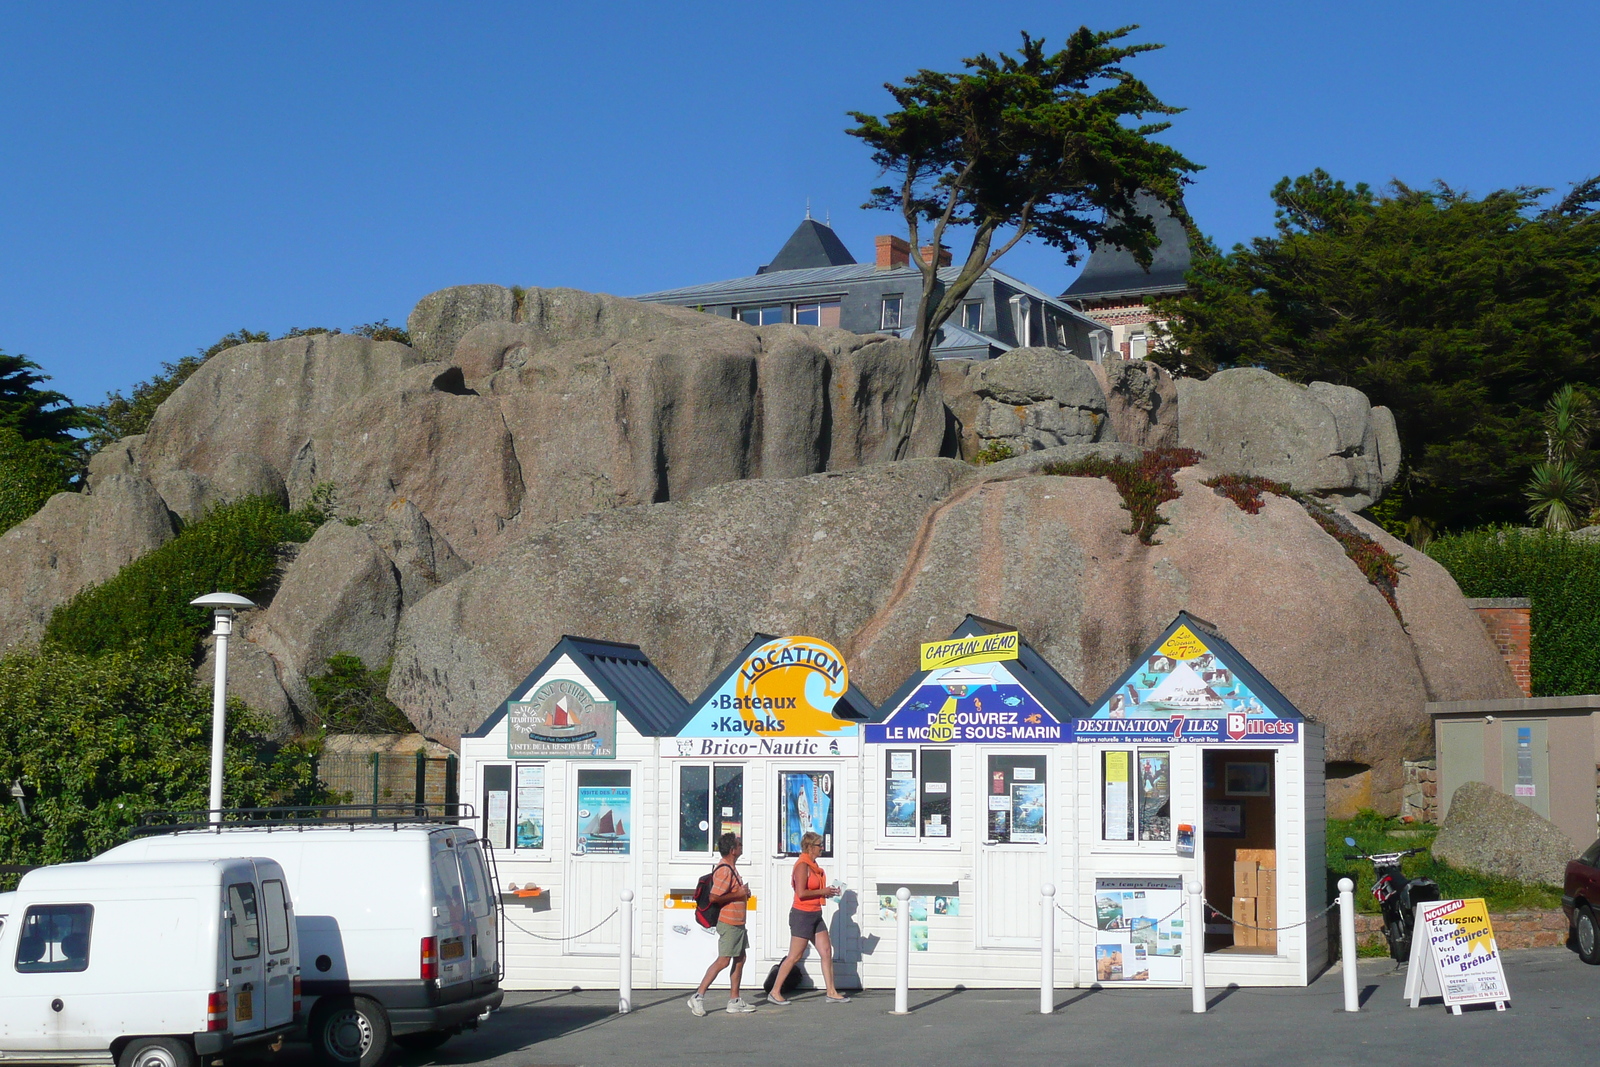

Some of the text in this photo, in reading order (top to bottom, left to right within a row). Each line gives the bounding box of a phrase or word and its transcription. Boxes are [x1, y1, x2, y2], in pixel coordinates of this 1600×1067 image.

[982, 634, 1016, 652] NÉMO
[1178, 646, 1188, 658] 7
[740, 647, 844, 681] LOCATION
[533, 683, 556, 710] SANT
[720, 694, 796, 710] Bateaux
[720, 716, 786, 736] Kayaks
[928, 711, 1018, 725] DÉCOUVREZ
[1076, 714, 1219, 738] DESTINATION 7 ILES
[1228, 714, 1294, 735] Billets
[886, 726, 1060, 739] LE MONDE SOUS-MARIN
[591, 738, 603, 756] 7
[700, 738, 818, 755] Brico-Nautic
[1425, 900, 1463, 920] NOUVEAU
[1432, 916, 1483, 927] EXCURSION
[1431, 926, 1466, 946] Perros
[1455, 927, 1489, 946] Guirec
[1440, 954, 1460, 968] l'île
[1460, 950, 1496, 972] Bréhat
